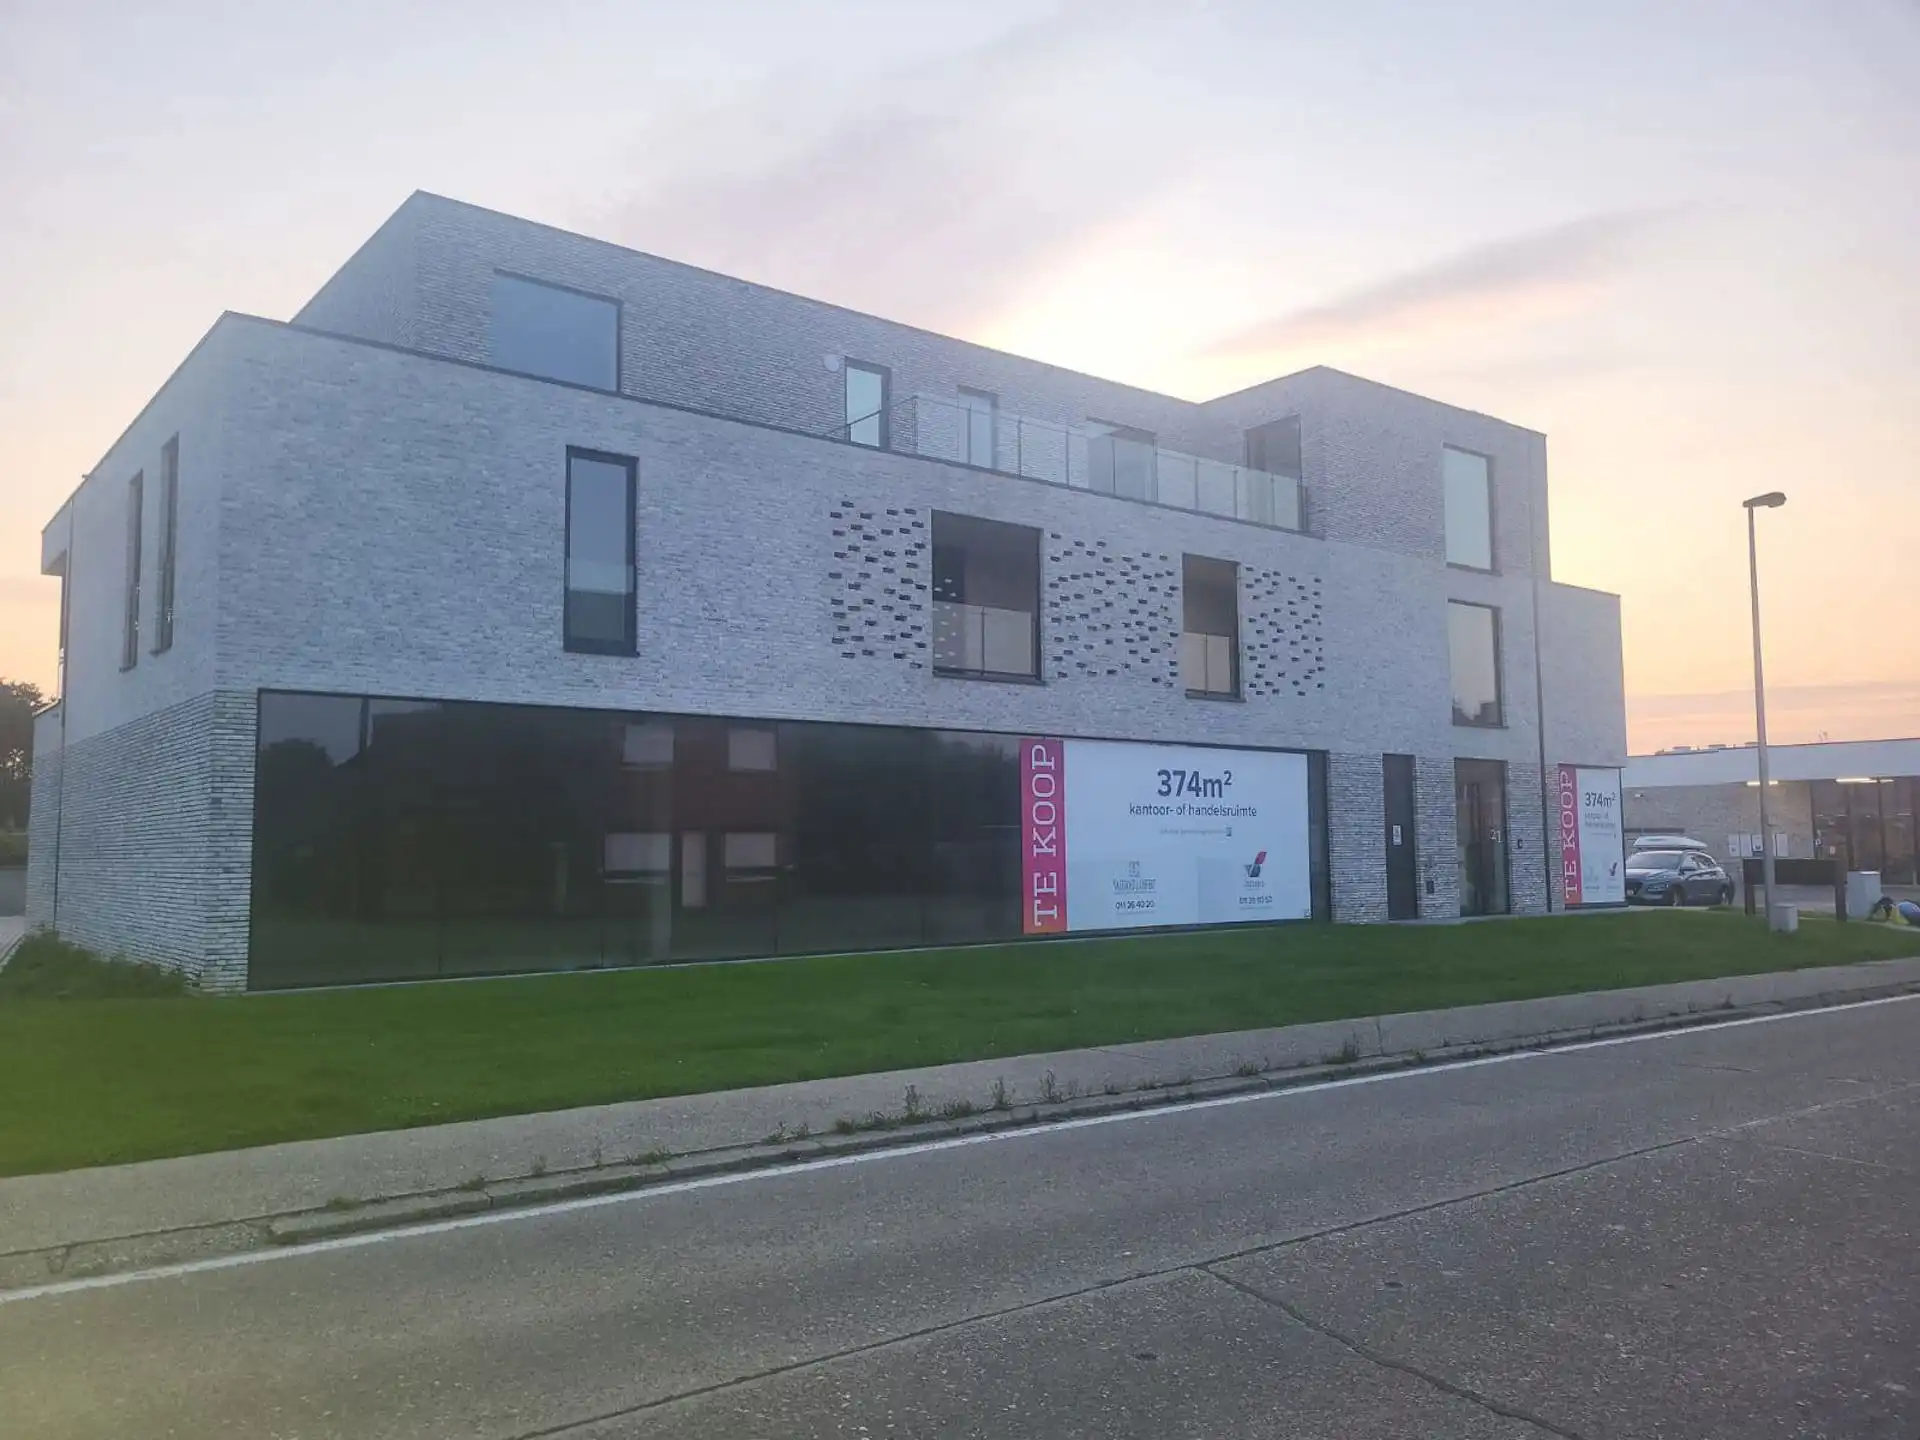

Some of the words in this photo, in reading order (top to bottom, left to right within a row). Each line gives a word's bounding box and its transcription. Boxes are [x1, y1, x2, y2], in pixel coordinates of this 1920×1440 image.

[1032, 744, 1056, 857] KOOP
[1129, 803, 1174, 817] kantoor-
[1176, 803, 1187, 816] of
[1188, 804, 1257, 817] handelsruimte
[1560, 771, 1576, 850] KOOP
[1034, 872, 1058, 927] TE
[1564, 860, 1578, 898] TE
